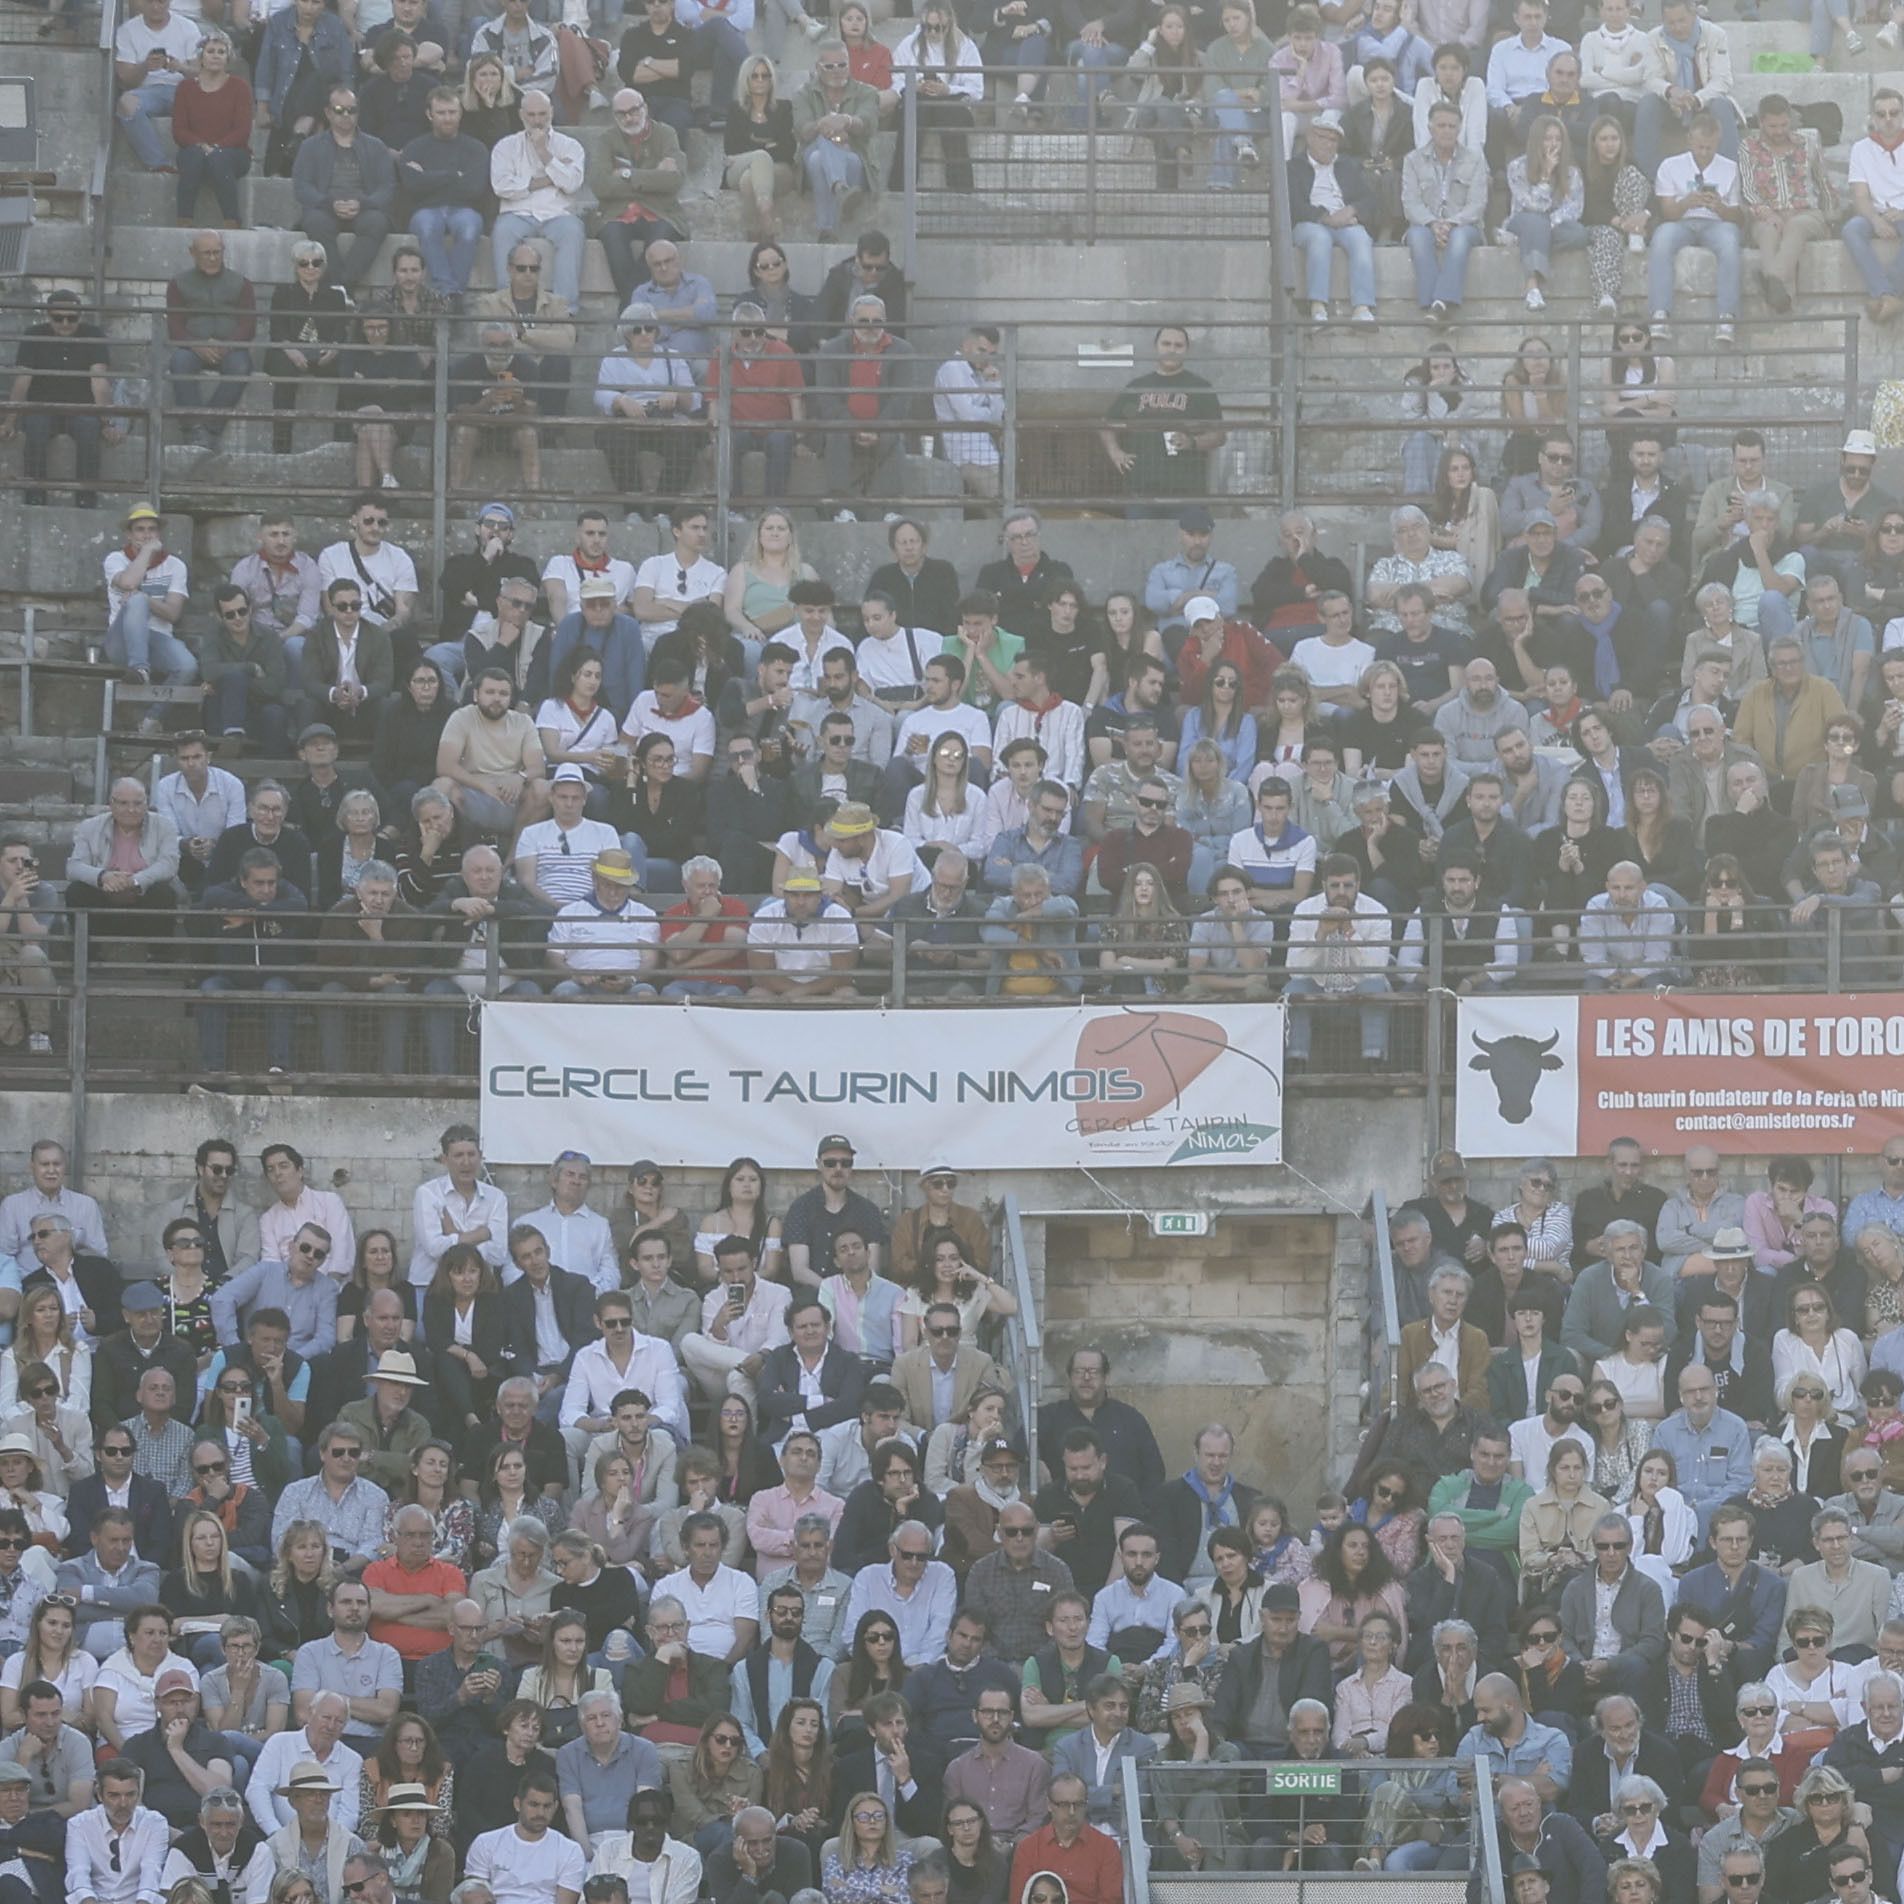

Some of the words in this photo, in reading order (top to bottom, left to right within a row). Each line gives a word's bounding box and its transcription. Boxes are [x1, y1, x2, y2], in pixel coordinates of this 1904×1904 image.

[1595, 1018, 1655, 1057] LES
[1662, 1017, 1755, 1057] AMIS
[1764, 1018, 1806, 1057] DE
[489, 1065, 710, 1101] CERCLE
[728, 1069, 937, 1104] TAURIN
[957, 1069, 1144, 1103] NIMOIS
[1597, 1091, 1634, 1109] Club
[1638, 1090, 1683, 1109] taurin
[1689, 1089, 1769, 1108] fondateur
[1772, 1089, 1793, 1107] de
[1796, 1090, 1812, 1107] la
[1815, 1090, 1856, 1108] Feria
[1858, 1091, 1878, 1108] de
[1065, 1115, 1157, 1133] CERCLE
[1164, 1112, 1249, 1132] TAURIN
[1675, 1112, 1856, 1132] contact@amisdetoros.fr
[1274, 1773, 1336, 1788] SORTIE
